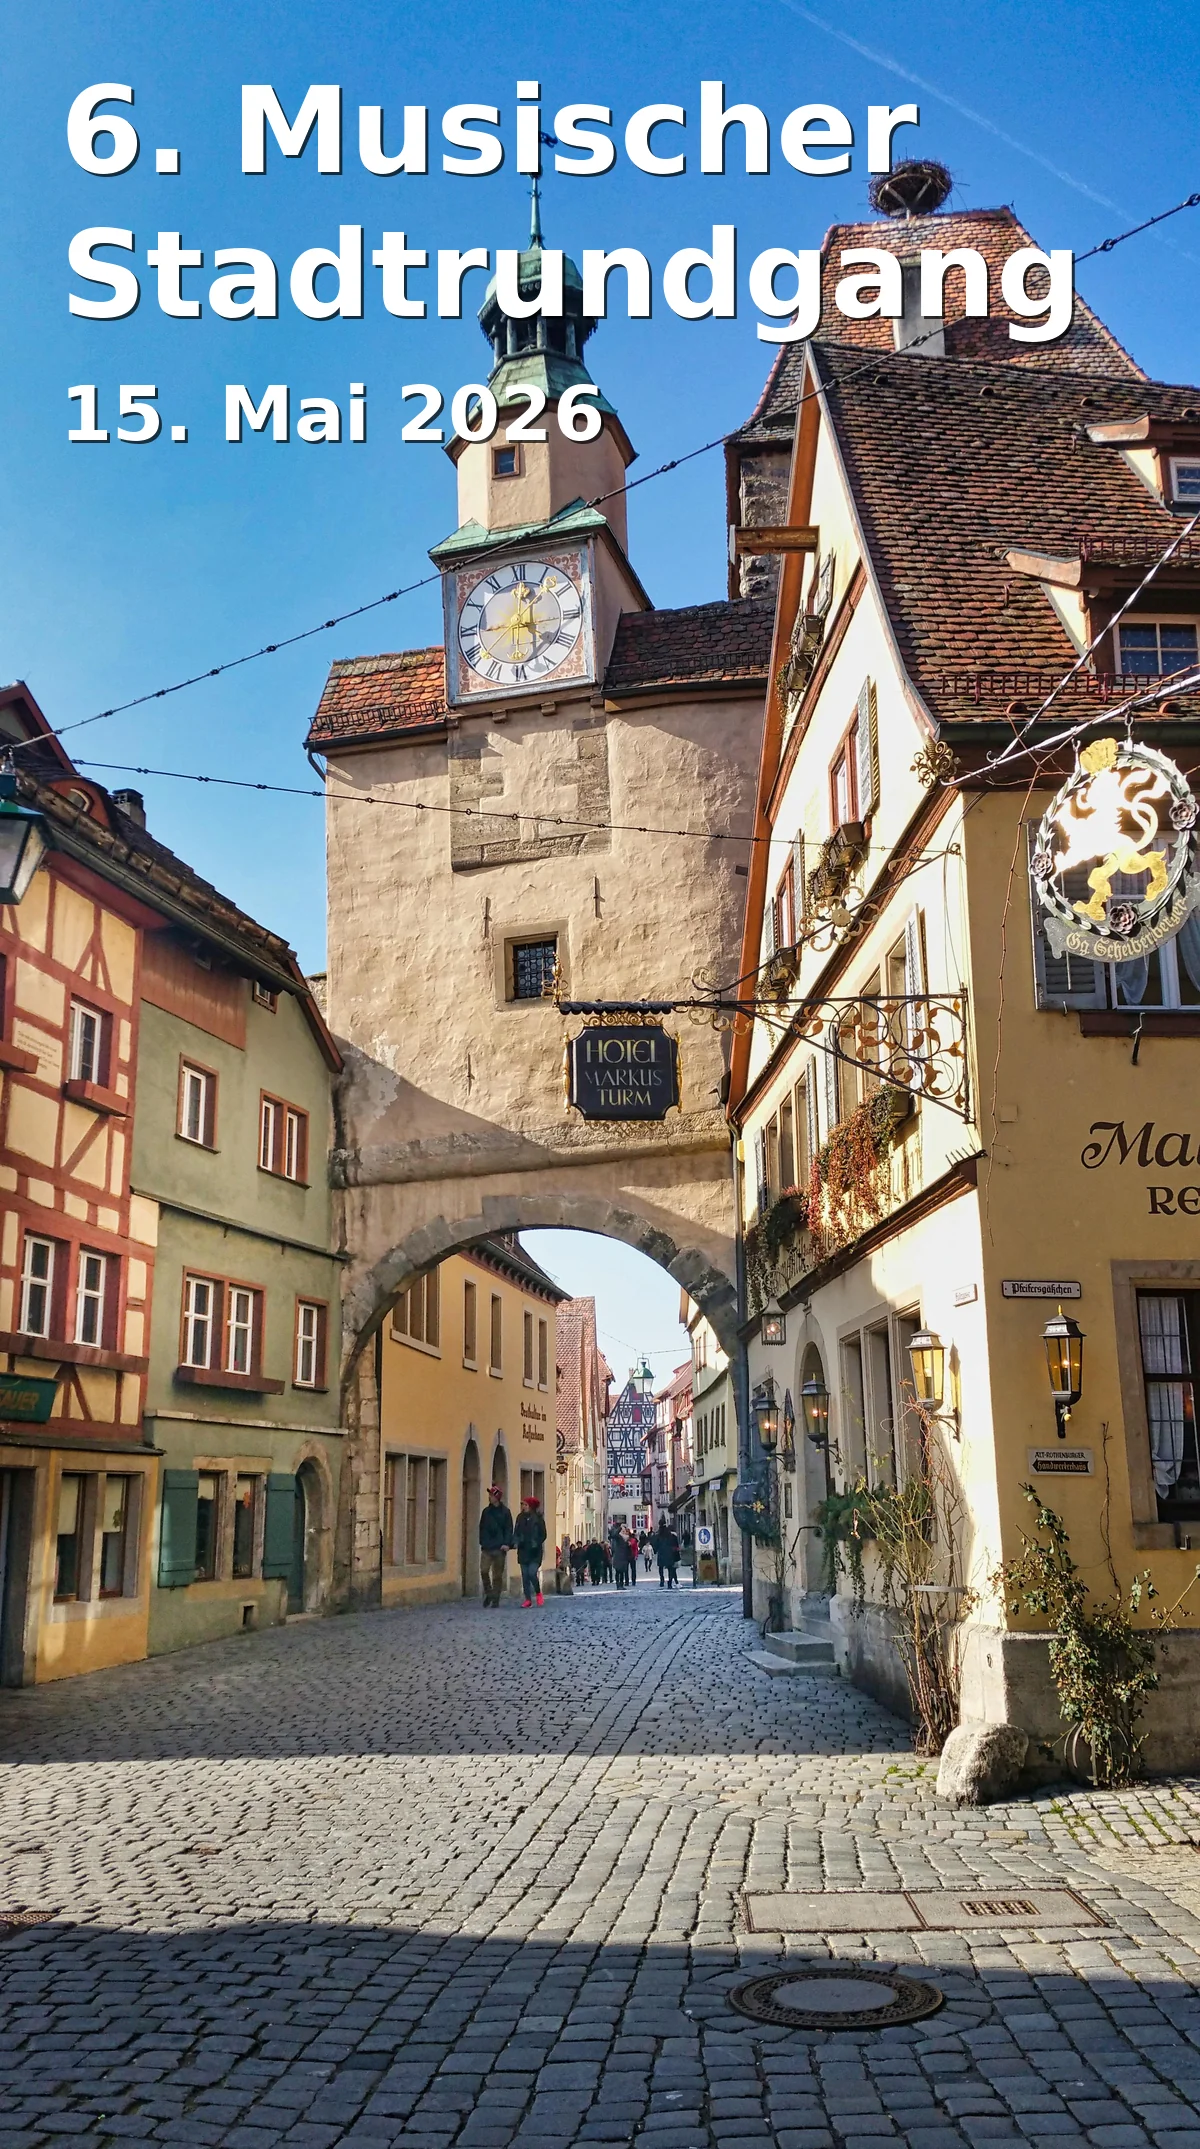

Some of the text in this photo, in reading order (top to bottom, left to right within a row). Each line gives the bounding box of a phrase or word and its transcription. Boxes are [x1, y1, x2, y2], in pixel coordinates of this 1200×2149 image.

[586, 1039, 661, 1063] HOTEL
[585, 1069, 663, 1086] MARKUS
[597, 1089, 652, 1106] TURM
[1081, 1121, 1200, 1169] Ma
